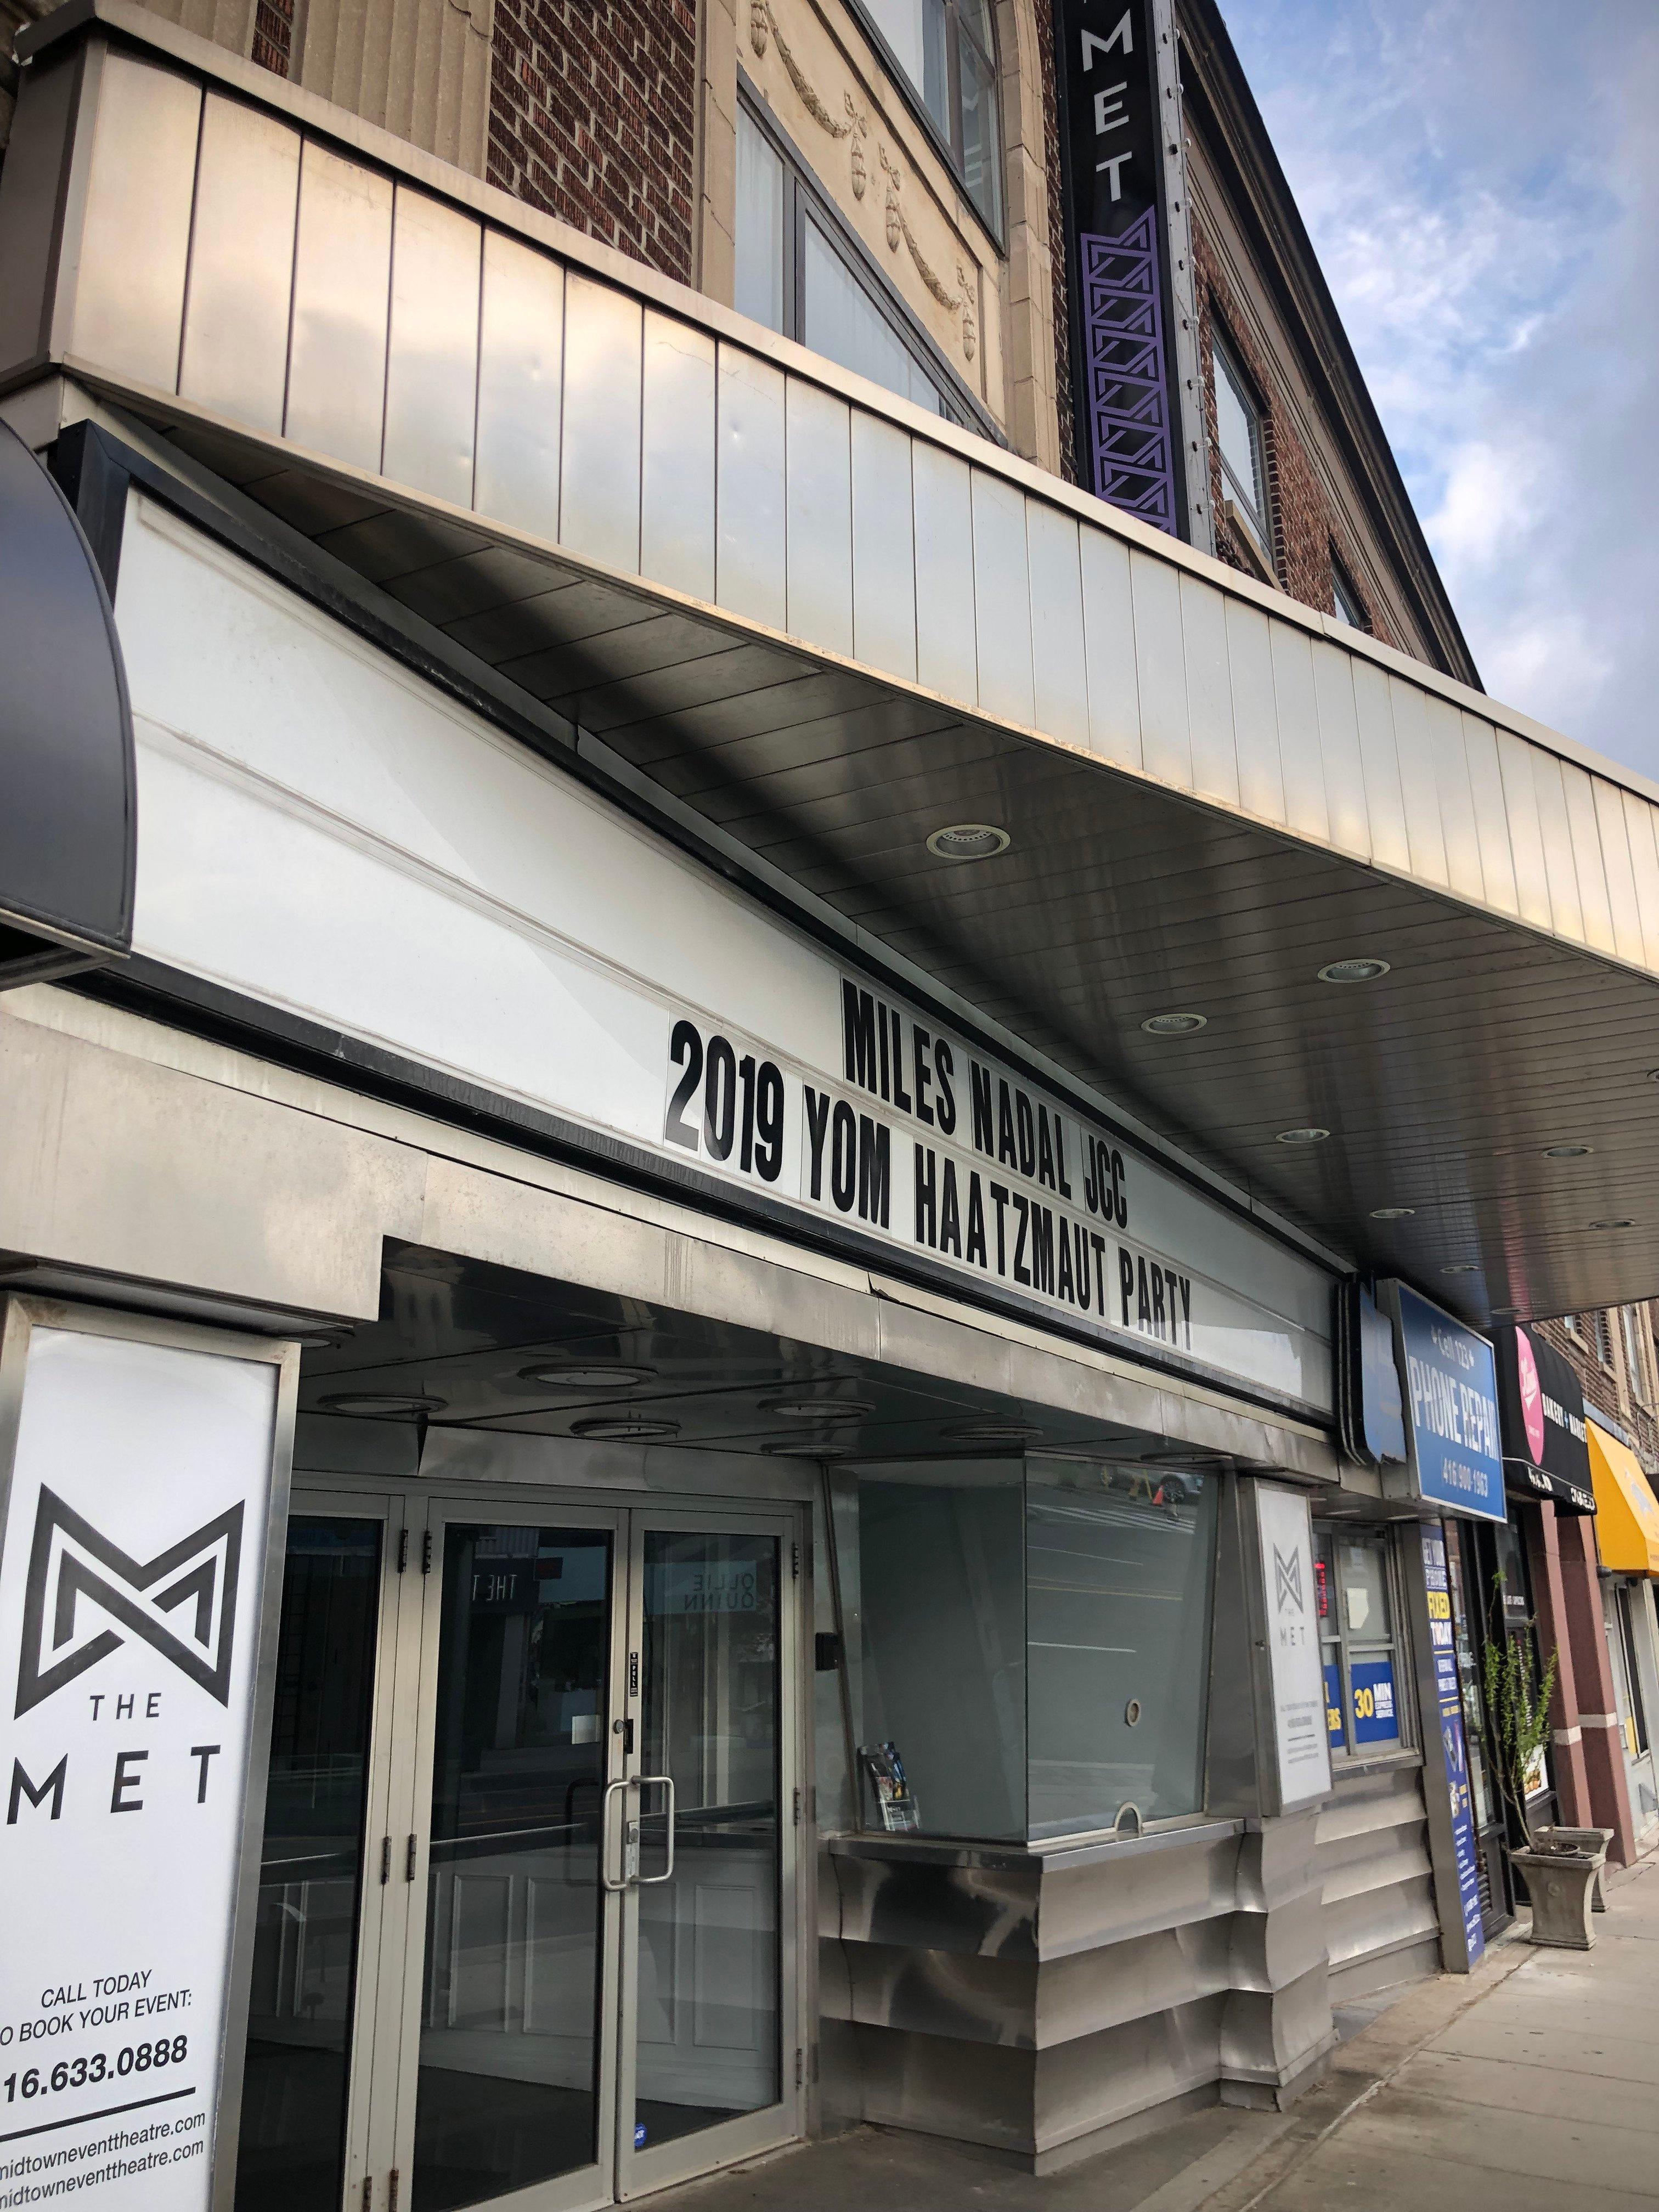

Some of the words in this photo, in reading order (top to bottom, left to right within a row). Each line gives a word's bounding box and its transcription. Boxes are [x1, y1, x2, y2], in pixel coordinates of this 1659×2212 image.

[1081, 8, 1133, 201] MET
[843, 978, 956, 1136] MILES
[971, 1060, 1071, 1200] NADAL
[1084, 1133, 1127, 1229] JCC
[666, 1020, 784, 1182] 2019
[804, 1084, 890, 1229] YOM
[915, 1144, 1105, 1316] HAATZMAUT
[1120, 1246, 1191, 1350] PARTY
[1409, 1355, 1462, 1444] PHONE
[89, 1692, 161, 1721] THE
[1355, 1688, 1374, 1718] 30
[7, 1745, 221, 1825] MET
[0, 2026, 14, 2045] O
[19, 2013, 74, 2042] BOOK
[80, 2001, 130, 2028] YOUR
[134, 1989, 193, 2017] EVENT:
[41, 1983, 87, 2008] CALL
[93, 1970, 152, 1997] TODAY
[4, 2035, 188, 2103] 16.633.0888
